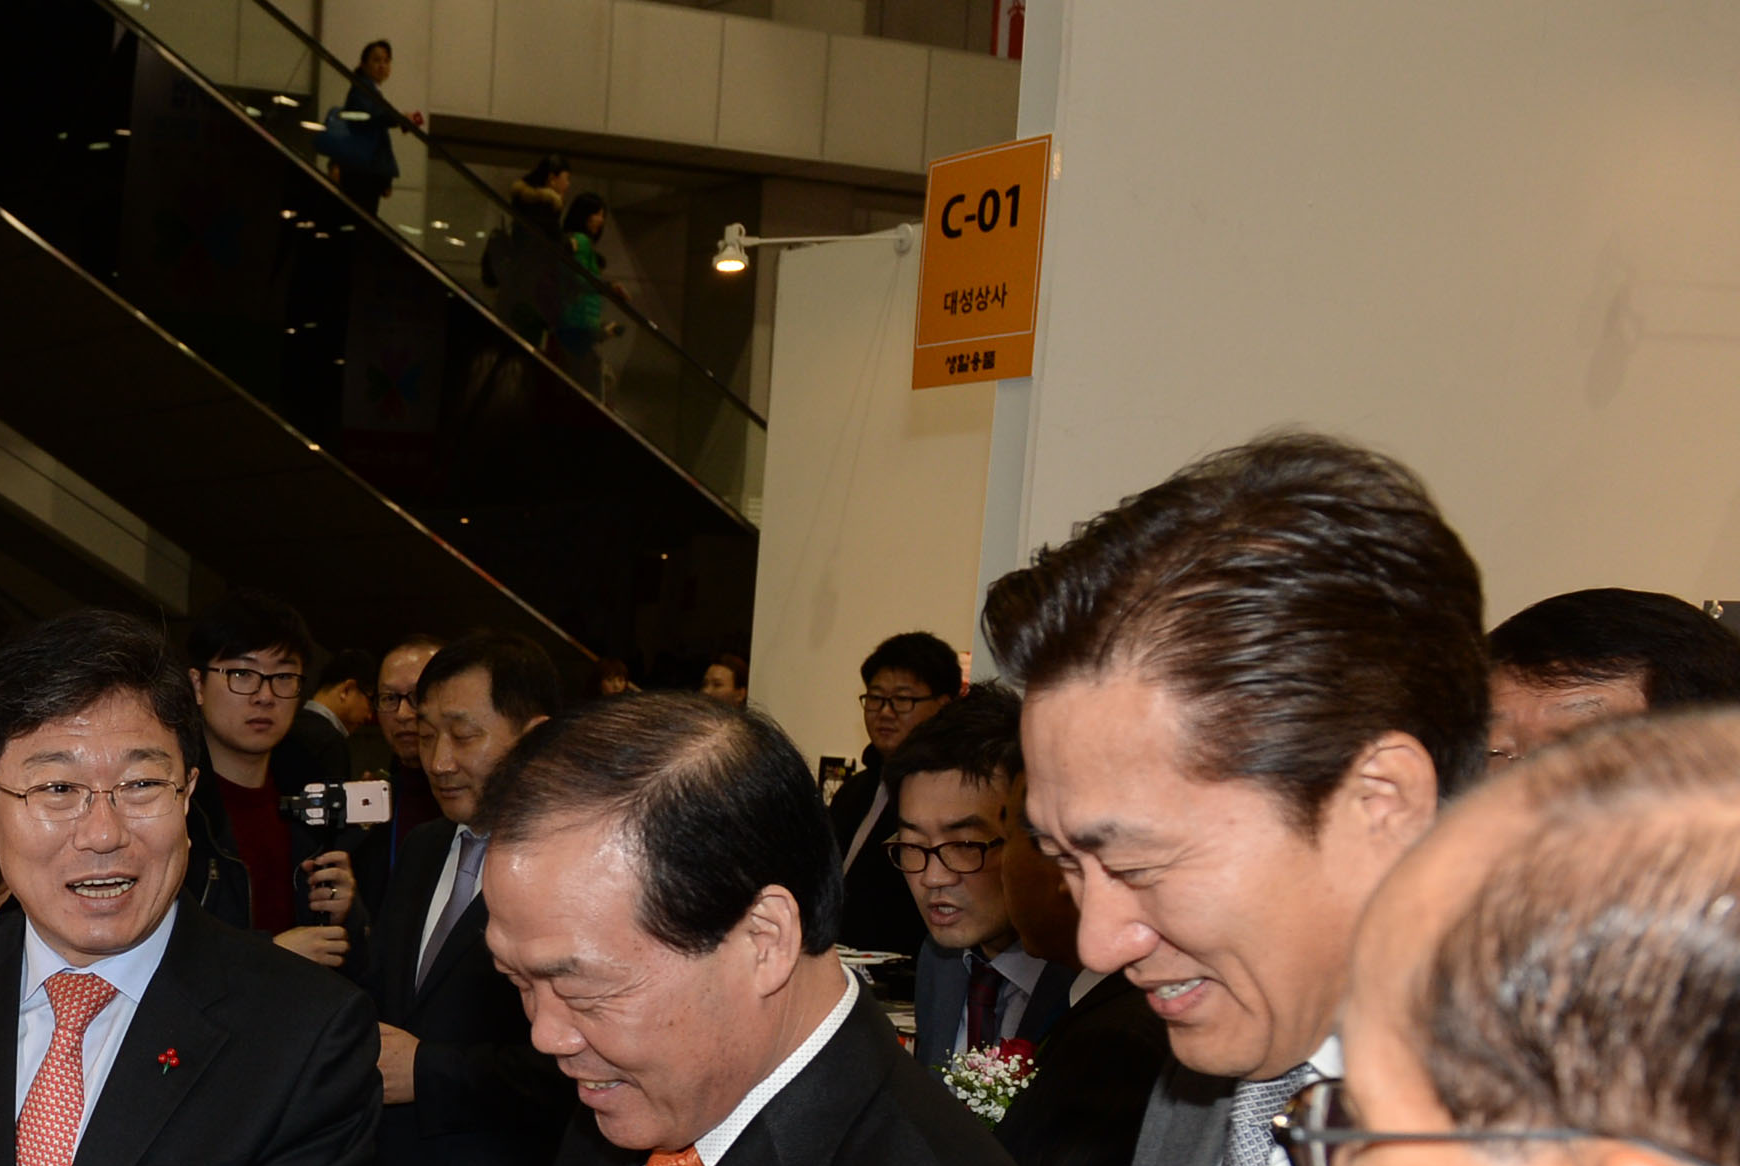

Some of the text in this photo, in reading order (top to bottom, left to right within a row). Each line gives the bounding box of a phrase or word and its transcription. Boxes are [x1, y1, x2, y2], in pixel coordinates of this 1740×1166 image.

[941, 184, 1020, 239] C-01
[943, 283, 1007, 315] 대성상사
[945, 350, 996, 375] 생활용품
